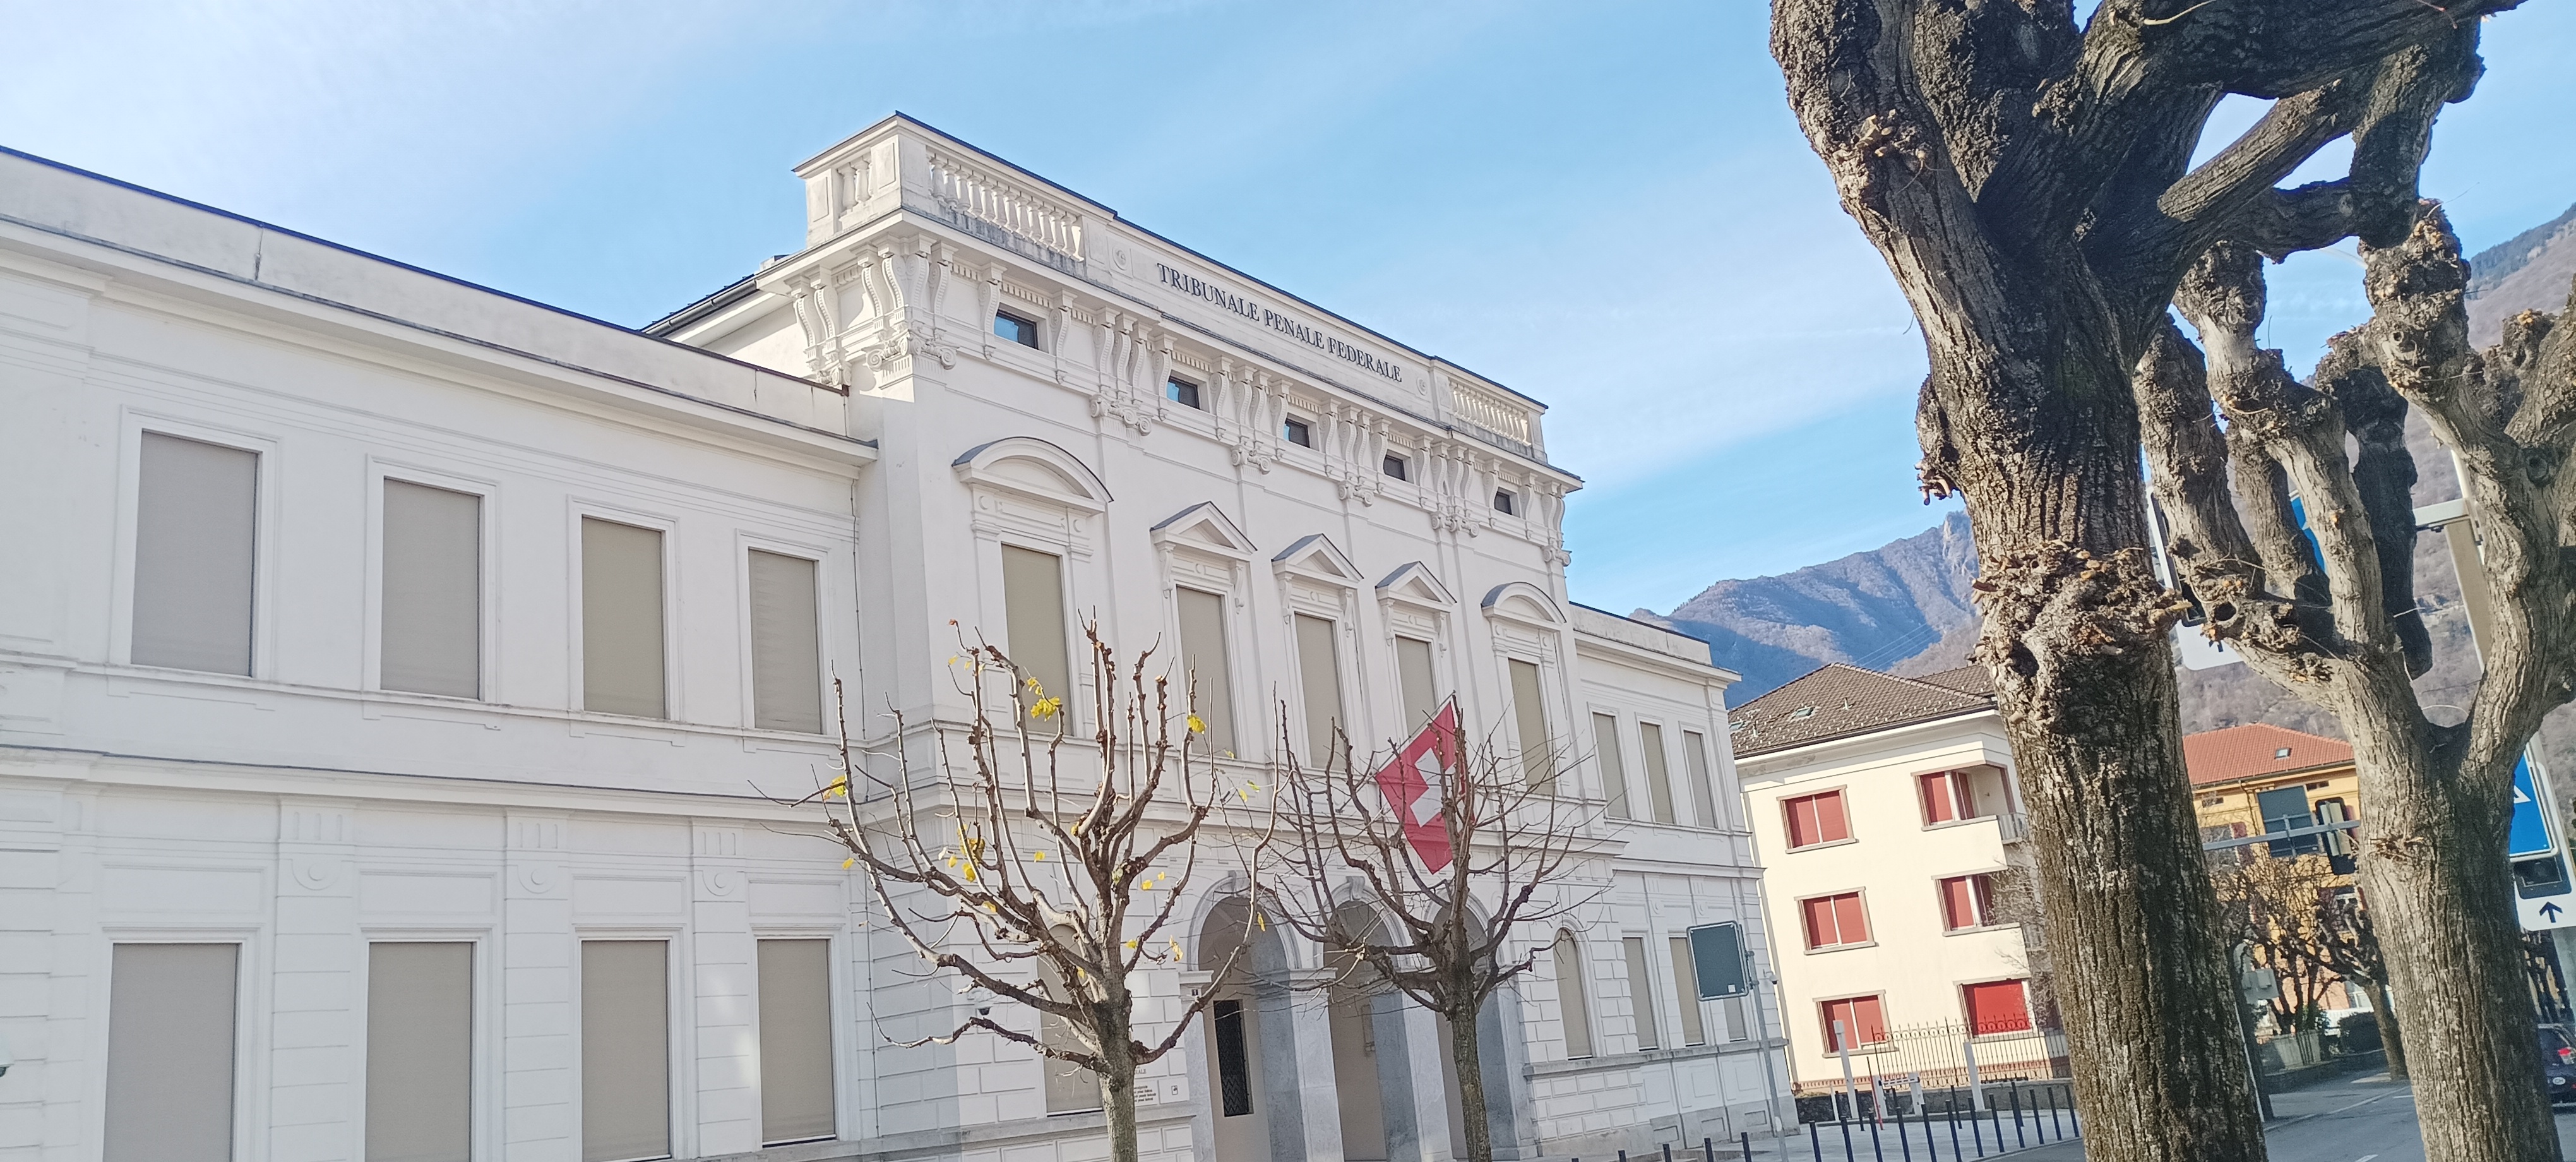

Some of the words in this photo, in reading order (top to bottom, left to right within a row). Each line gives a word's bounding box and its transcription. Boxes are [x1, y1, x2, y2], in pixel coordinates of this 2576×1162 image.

[1157, 263, 1260, 321] TRIBUNALE
[1264, 309, 1325, 349] PENALE
[1328, 337, 1402, 383] FEDERALE
